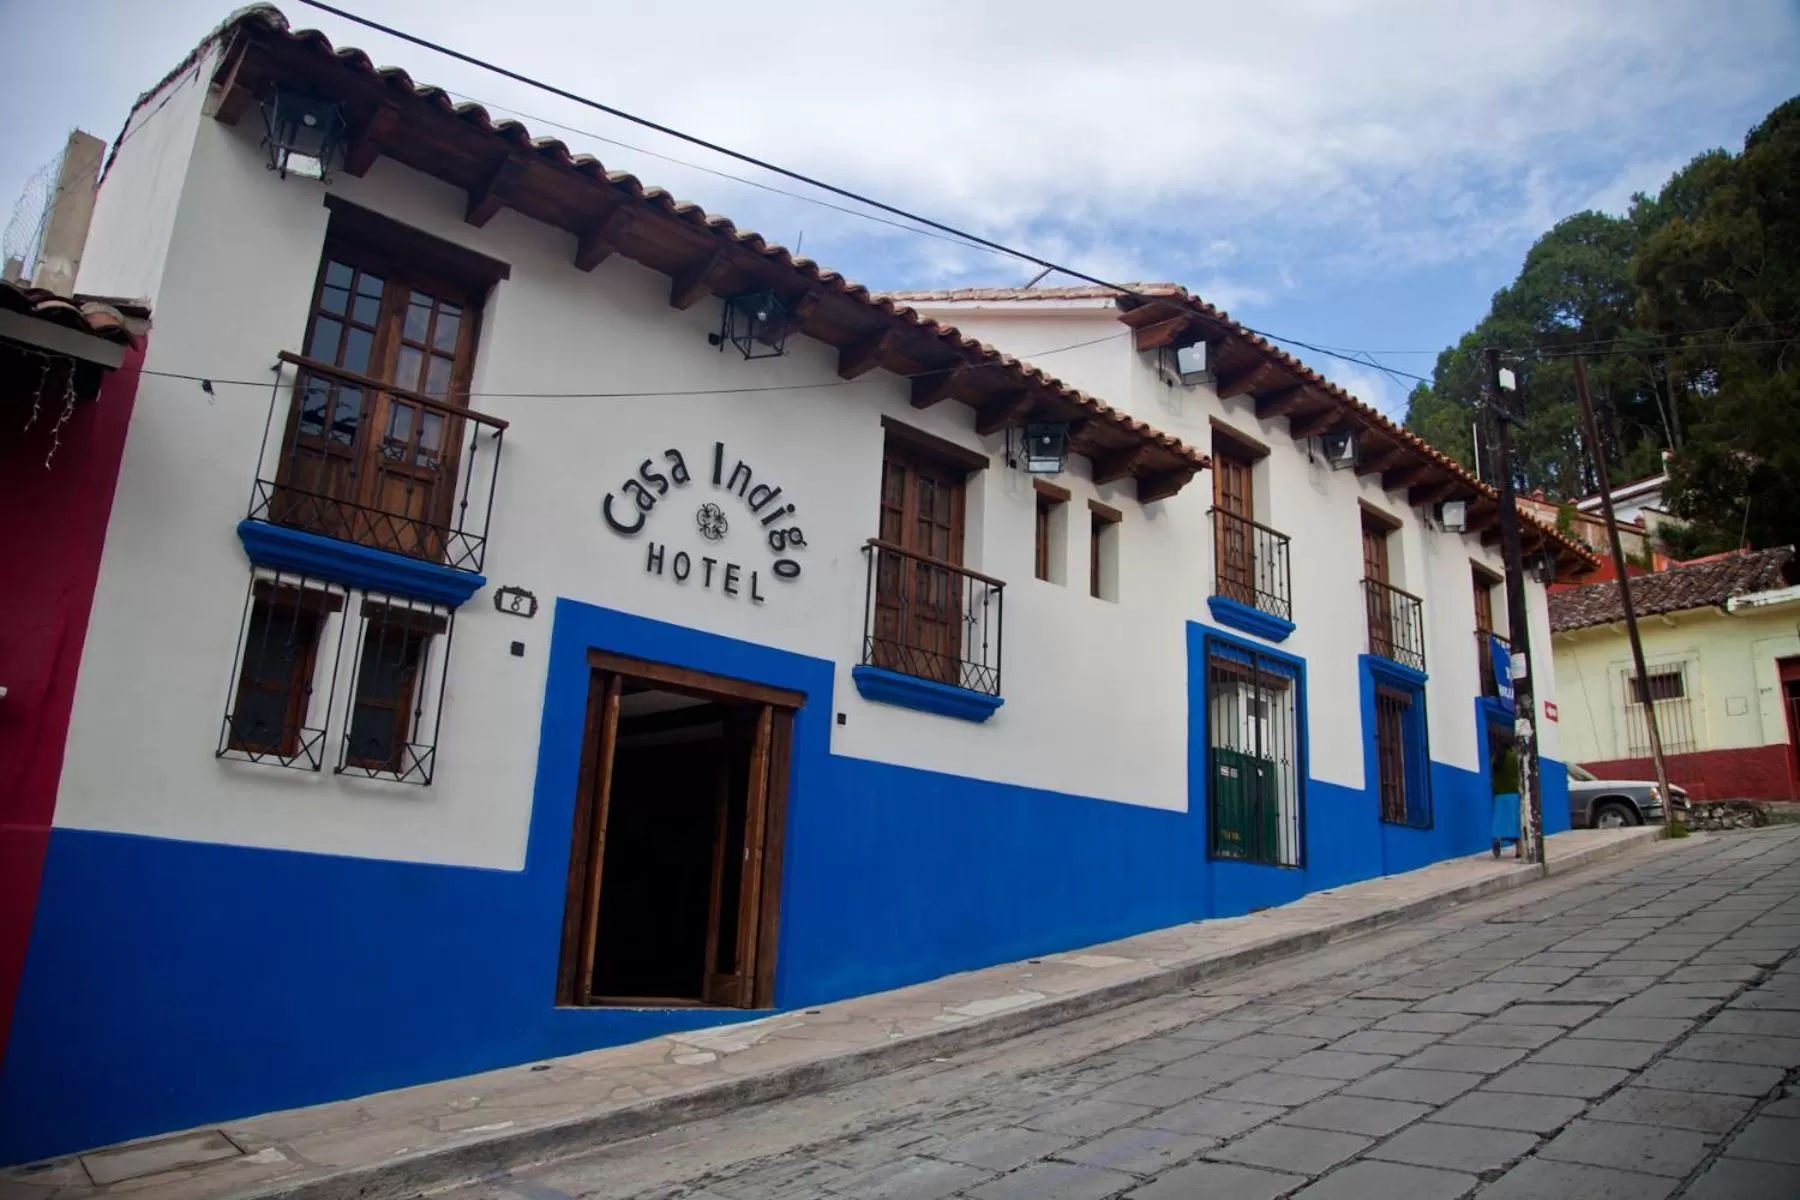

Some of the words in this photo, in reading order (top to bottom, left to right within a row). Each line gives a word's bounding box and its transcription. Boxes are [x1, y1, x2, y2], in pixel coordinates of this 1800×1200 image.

[602, 448, 691, 537] Casa
[711, 441, 808, 579] Indigo
[646, 541, 765, 602] HOTEL
[511, 595, 523, 612] 8
